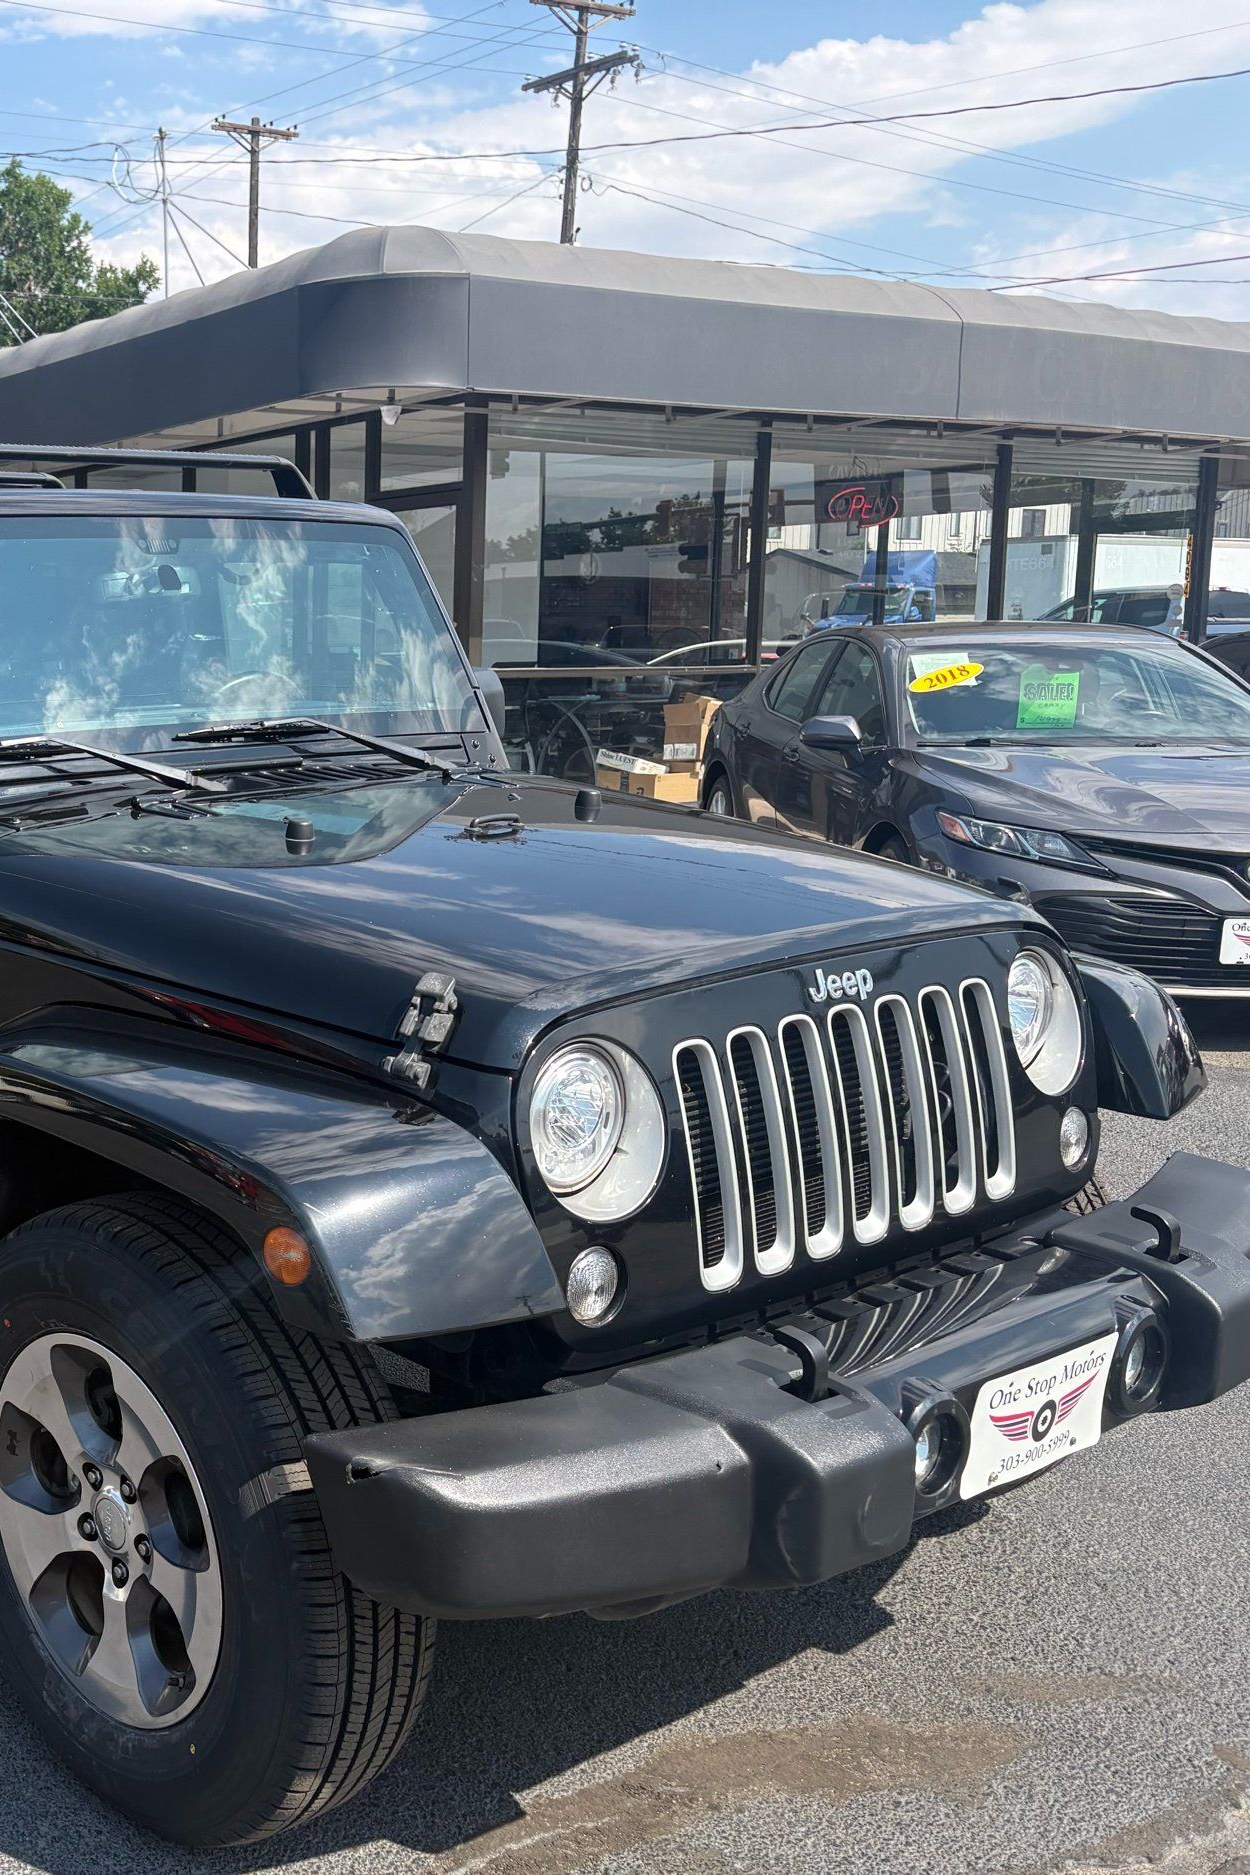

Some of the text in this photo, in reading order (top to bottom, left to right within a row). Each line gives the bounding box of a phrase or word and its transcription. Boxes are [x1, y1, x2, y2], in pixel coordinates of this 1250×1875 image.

[923, 665, 970, 689] 2018
[1023, 682, 1075, 702] SALE!
[807, 968, 874, 1002] Jeep
[989, 1352, 1107, 1410] One Stop Motors
[997, 1429, 1070, 1474] 303-900-5999
